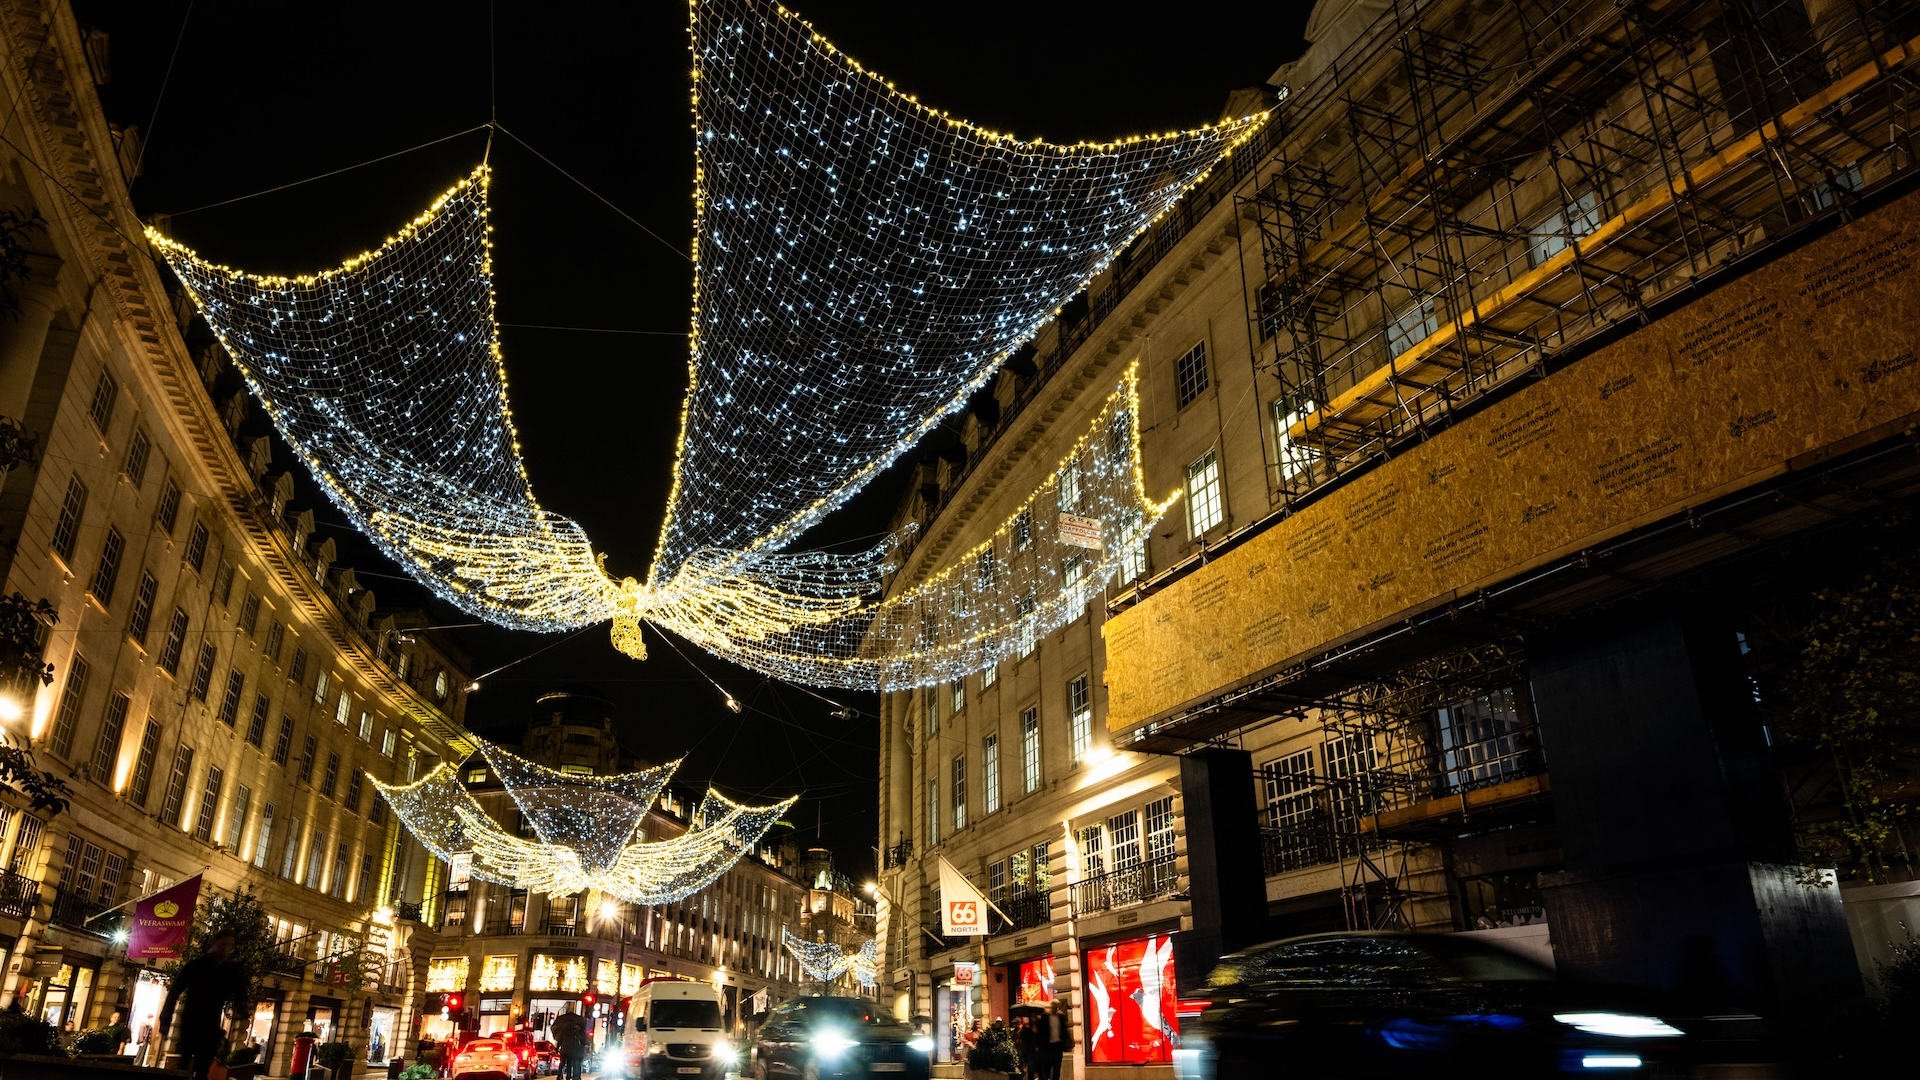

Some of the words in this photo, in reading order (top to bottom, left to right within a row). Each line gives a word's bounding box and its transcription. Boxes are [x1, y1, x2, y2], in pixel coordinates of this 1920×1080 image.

[1799, 262, 1861, 296] wildflower
[1865, 236, 1917, 266] meadow
[1819, 265, 1831, 273] are
[1834, 248, 1868, 268] growing
[1876, 231, 1902, 246] native
[1815, 289, 1834, 301] from
[1836, 278, 1855, 290] seed
[1868, 260, 1899, 277] provide
[1817, 296, 1840, 309] haven
[1843, 289, 1854, 298] for
[1856, 278, 1876, 292] local
[1878, 263, 1910, 281] wildlife
[1679, 324, 1731, 354] wildflower
[1734, 301, 1778, 327] meadow
[1708, 311, 1736, 328] growing
[1744, 296, 1766, 309] native
[1692, 348, 1708, 359] from
[1710, 340, 1726, 350] seed
[1736, 322, 1763, 338] provide
[1882, 351, 1913, 367] Vertical
[1883, 358, 1918, 376] Meadow
[1487, 424, 1525, 447] wildflower
[1528, 407, 1560, 426] meadow
[1593, 460, 1640, 484] wildflower
[1643, 443, 1682, 463] meadow
[1423, 540, 1458, 559] wildflower
[1460, 526, 1488, 541] meadow
[1501, 907, 1530, 916] WELCOME
